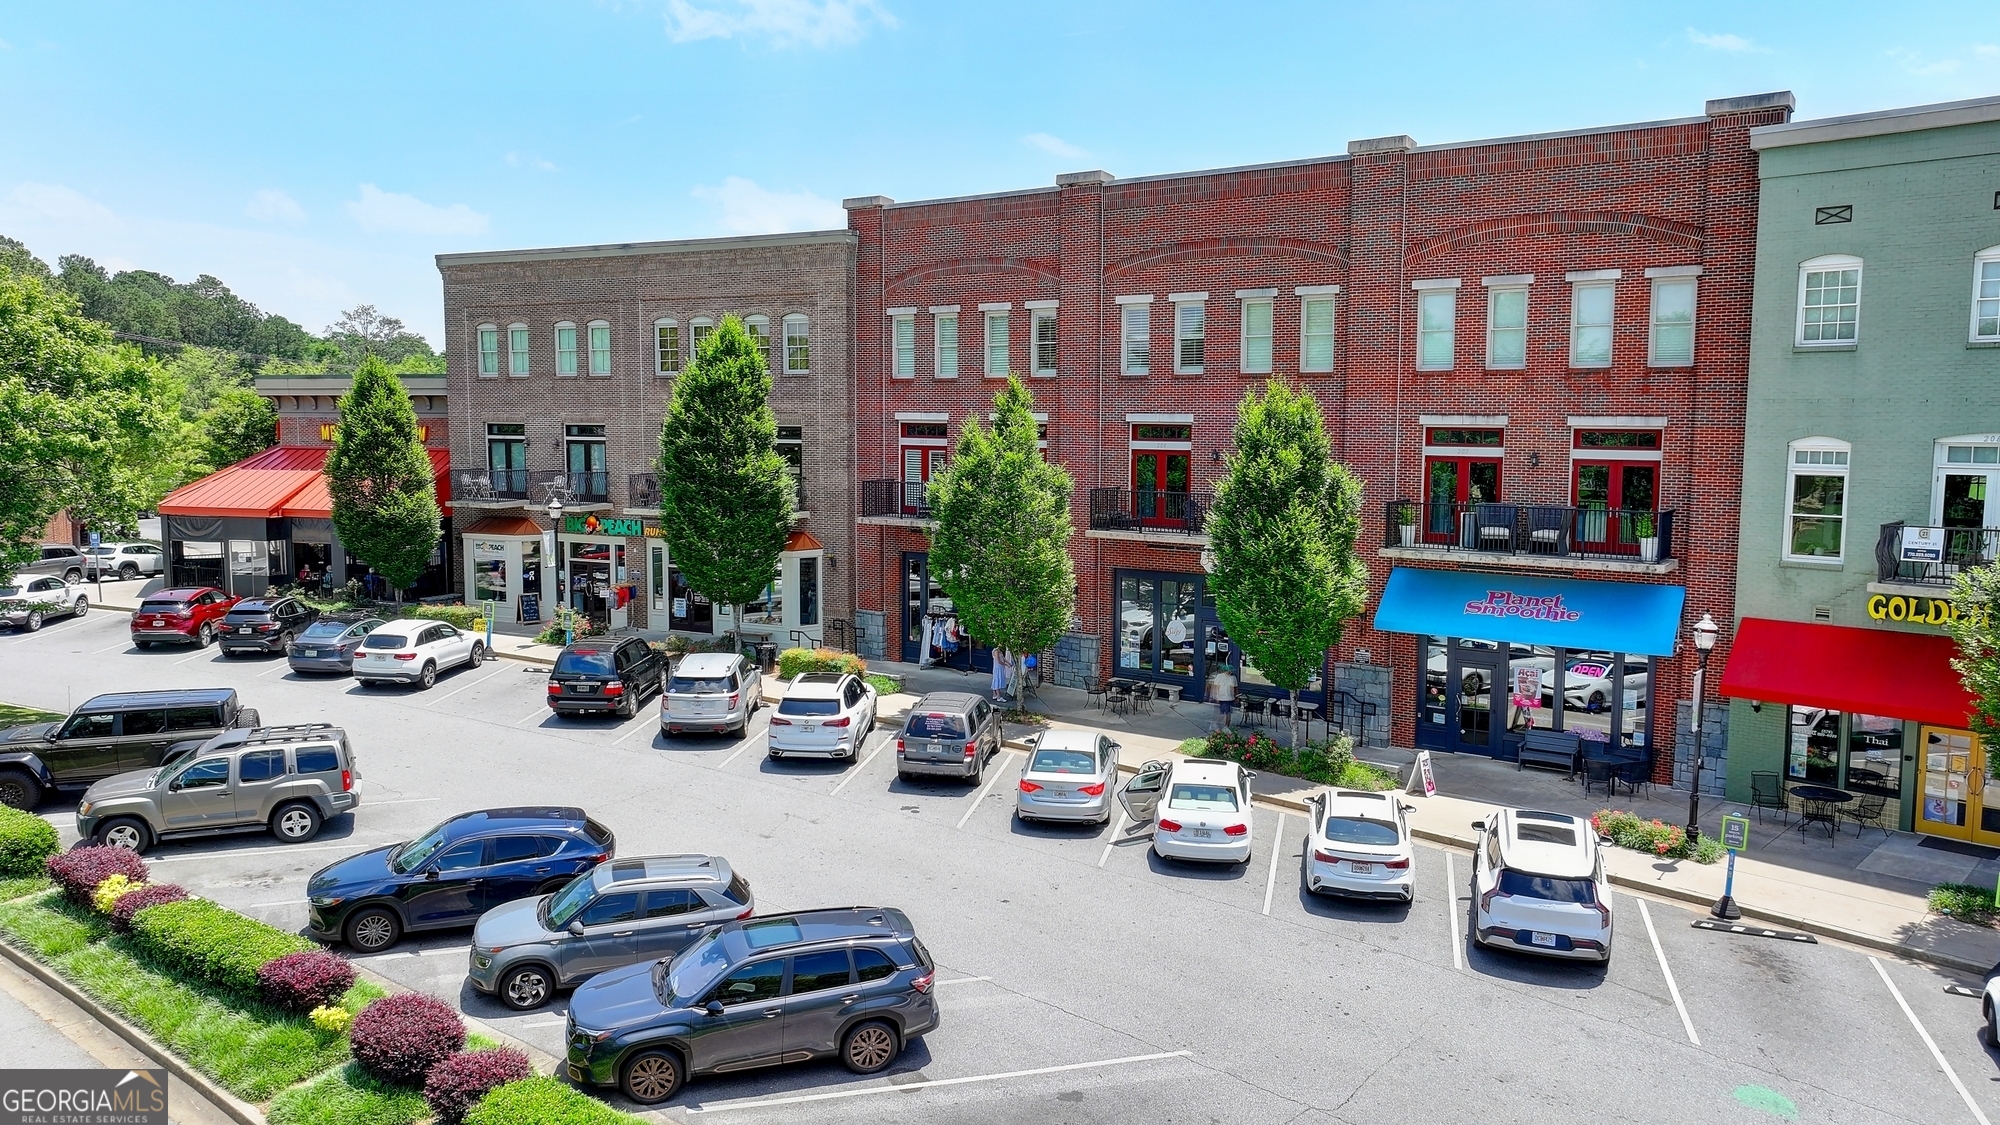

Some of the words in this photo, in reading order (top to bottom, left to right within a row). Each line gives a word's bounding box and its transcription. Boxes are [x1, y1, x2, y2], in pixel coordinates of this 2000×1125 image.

[565, 516, 587, 533] BIG
[600, 519, 642, 536] PEACH
[1487, 590, 1562, 609] Planet
[1464, 600, 1580, 622] Smoothie
[1573, 664, 1604, 678] OPEN
[1863, 735, 1889, 746] Thai
